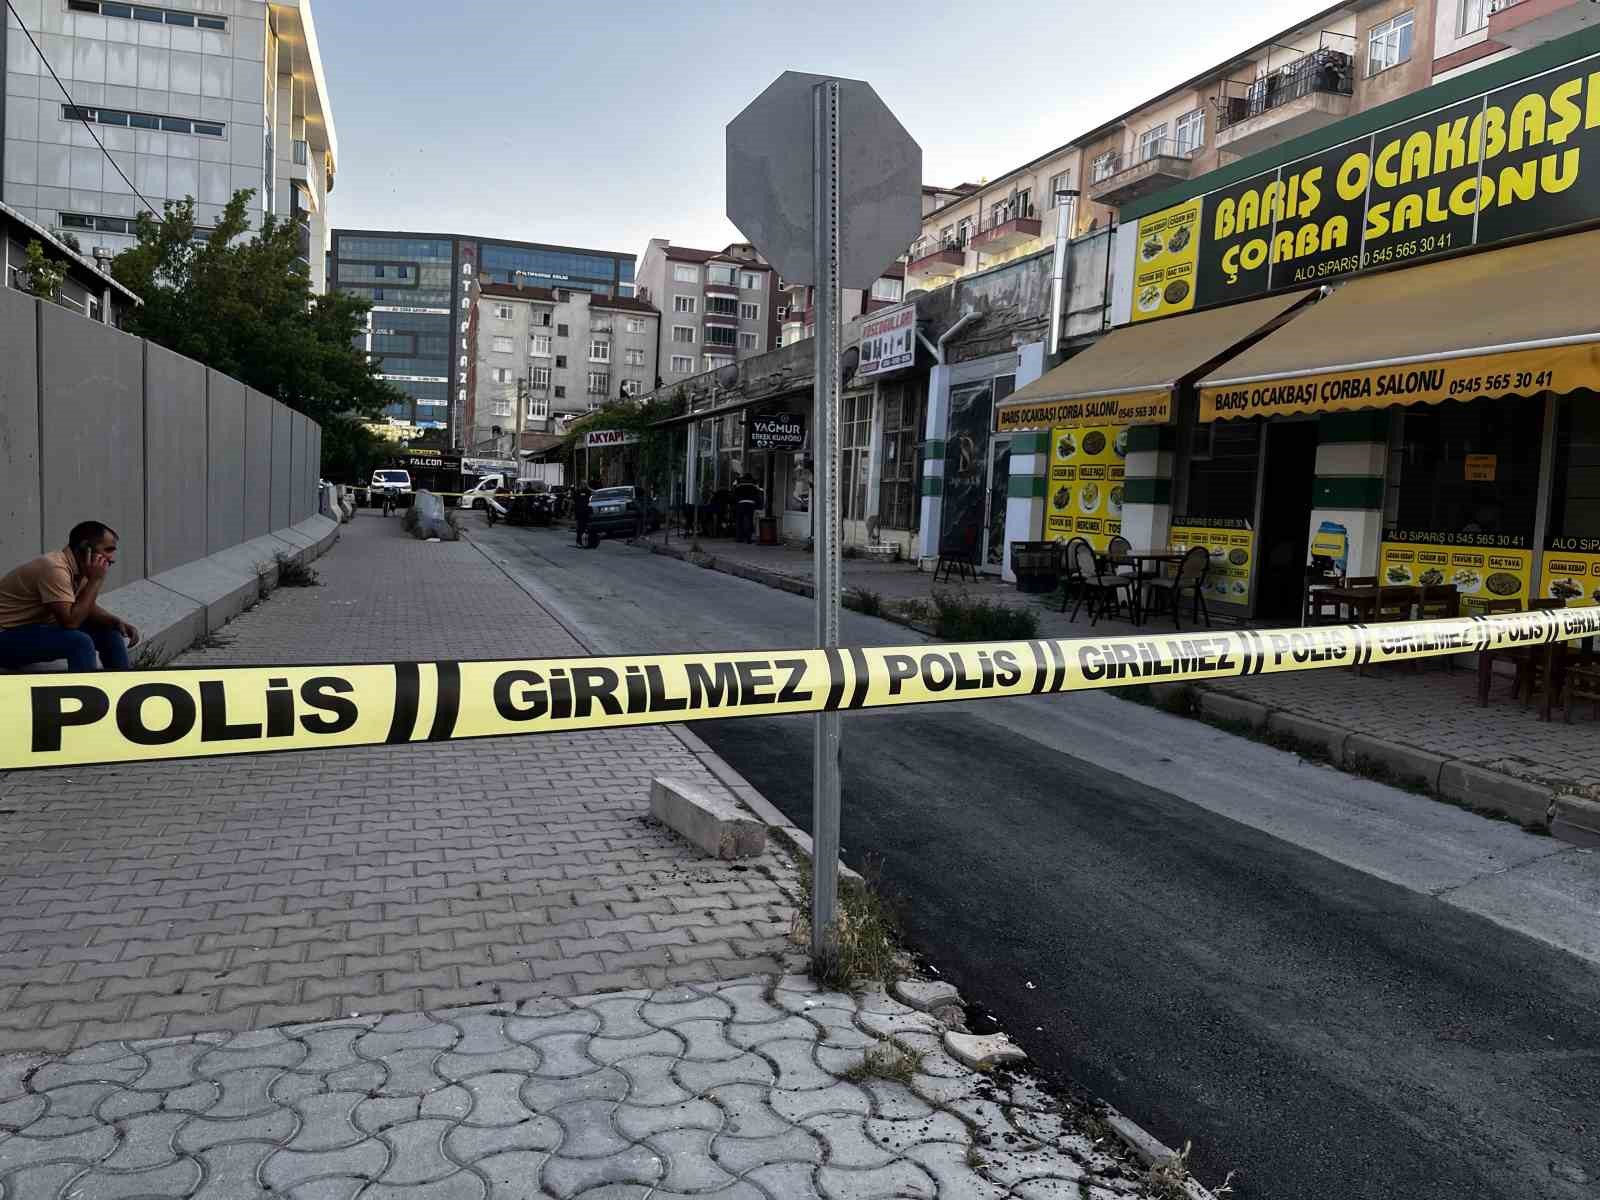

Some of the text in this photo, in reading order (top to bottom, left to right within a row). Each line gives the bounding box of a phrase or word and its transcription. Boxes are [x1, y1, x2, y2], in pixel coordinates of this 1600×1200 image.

[1215, 166, 1323, 240] BARIŞ
[1222, 147, 1580, 285] ÇORBA SALONU
[1294, 264, 1315, 281] ALO
[1363, 252, 1370, 266] 0
[1374, 245, 1393, 263] 545
[1396, 240, 1417, 259] 565
[1420, 237, 1435, 255] 30
[1437, 233, 1452, 251] 41
[1215, 368, 1553, 410] BARIŞ OCAKBAŞI ÇORBA SALONU 0545 565 30 41
[1057, 403, 1084, 421] ÇORBA
[1085, 400, 1119, 418] SALONU
[1147, 406, 1157, 417] 30
[1158, 405, 1167, 416] 41
[589, 431, 624, 444] AKYAPI
[754, 421, 800, 434] YAĞMUR
[1388, 530, 1408, 541] ALO
[1455, 533, 1474, 544] 545
[1476, 534, 1496, 545] 565
[1497, 535, 1510, 546] 30
[1511, 535, 1525, 546] 41
[1551, 538, 1600, 551] ALO SiP
